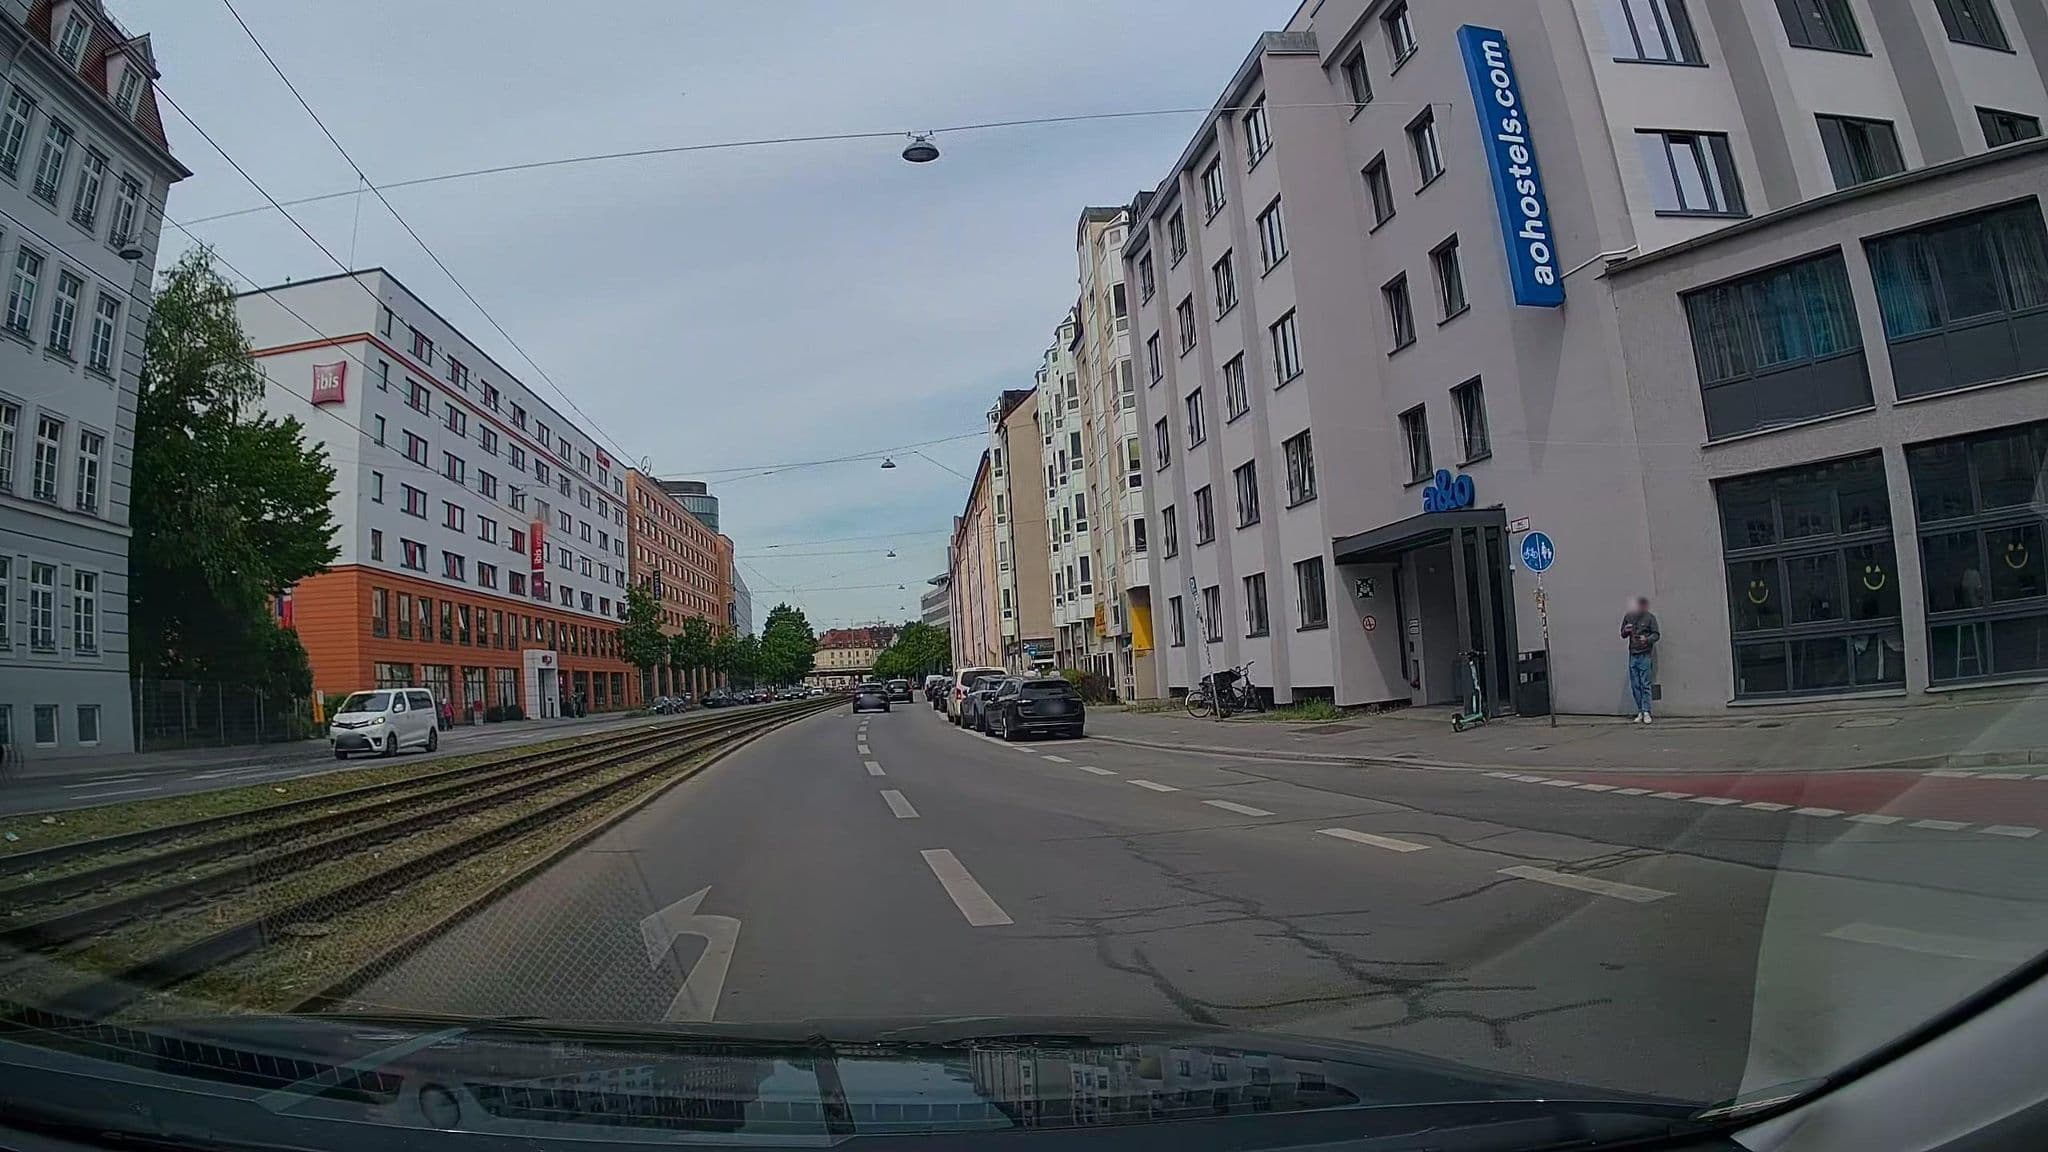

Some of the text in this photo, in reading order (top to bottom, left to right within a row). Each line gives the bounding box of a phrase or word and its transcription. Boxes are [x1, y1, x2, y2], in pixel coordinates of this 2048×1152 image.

[1481, 39, 1555, 286] aohostels.com
[316, 372, 340, 390] ibis
[1422, 469, 1475, 512] a&o
[533, 548, 542, 565] ibis
